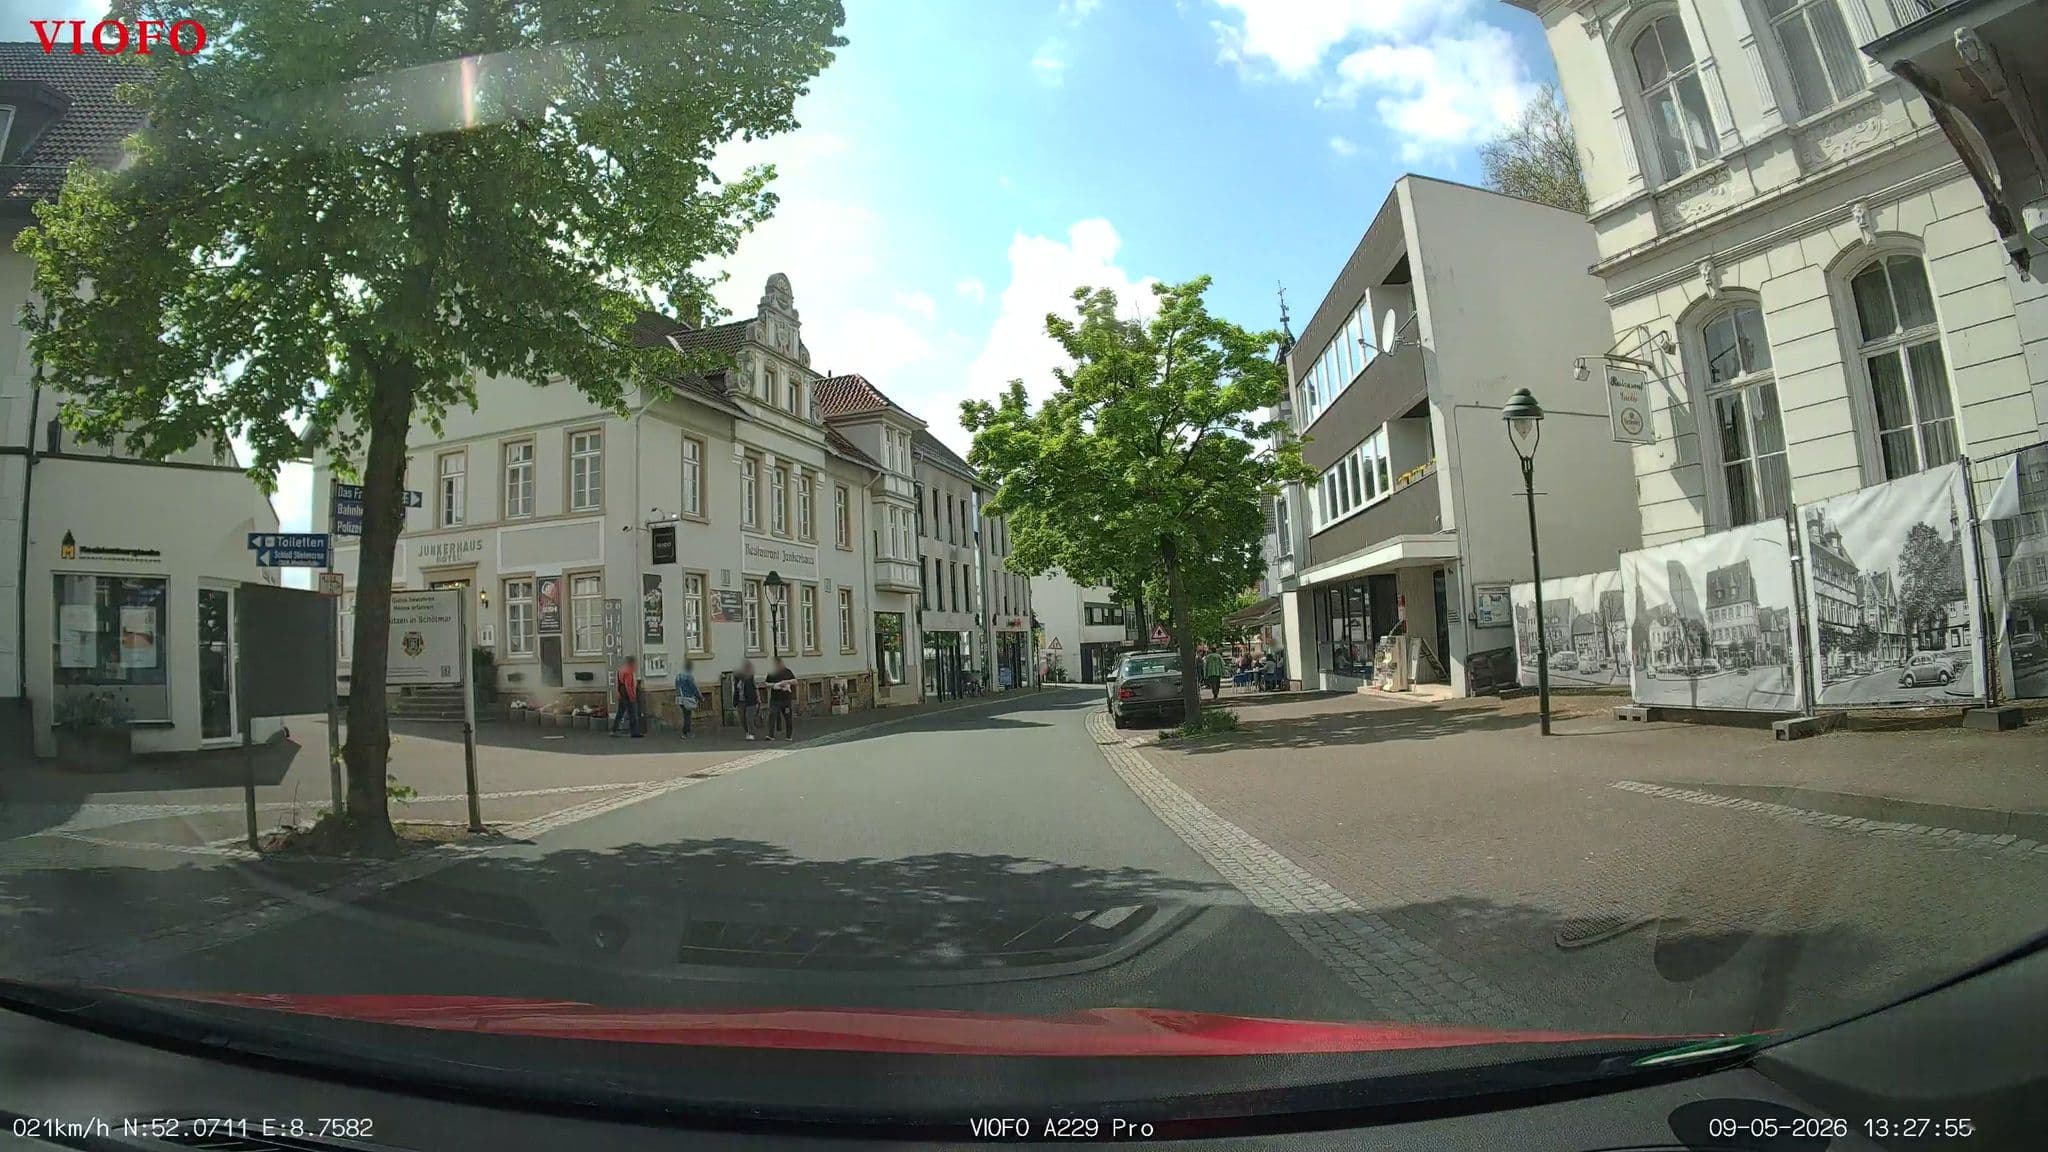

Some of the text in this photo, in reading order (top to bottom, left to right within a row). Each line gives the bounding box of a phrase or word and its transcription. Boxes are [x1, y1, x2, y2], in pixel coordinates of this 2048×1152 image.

[278, 536, 324, 548] Toiletten
[418, 540, 482, 557] JUNKERHAUS
[745, 543, 780, 559] Restaurant
[605, 613, 616, 705] HOTEL
